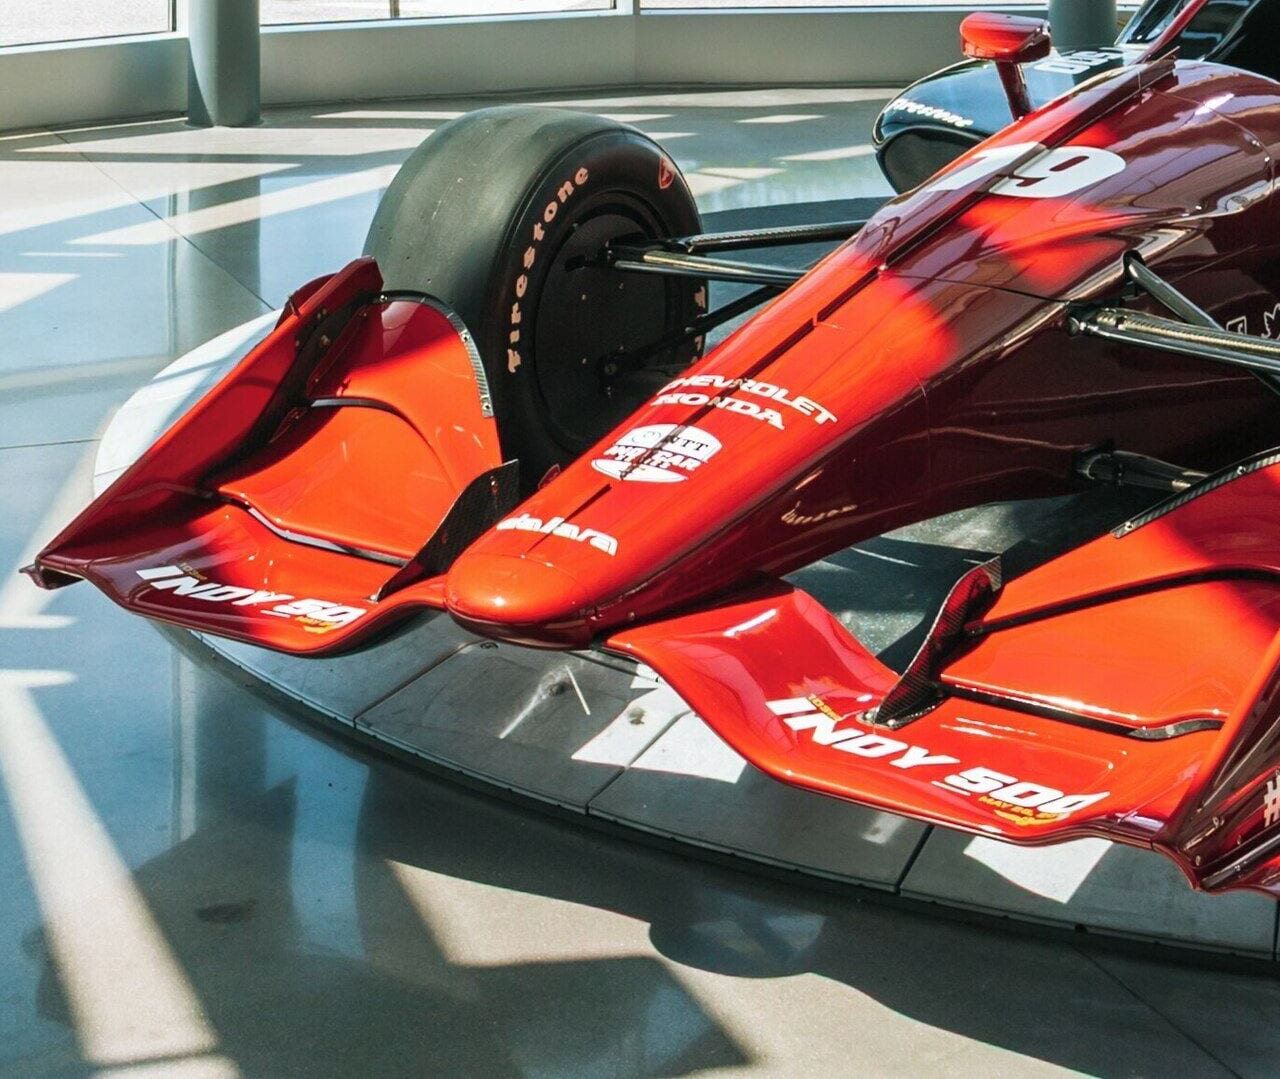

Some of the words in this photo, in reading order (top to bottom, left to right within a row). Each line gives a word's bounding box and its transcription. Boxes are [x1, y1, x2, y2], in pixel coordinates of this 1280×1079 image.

[883, 98, 974, 128] Firestone
[925, 141, 1127, 199] 19
[508, 166, 589, 374] Firestone
[650, 392, 786, 431] HONDA
[657, 374, 838, 425] CHEVROLET
[496, 513, 620, 557] dallara
[136, 564, 295, 607] INDY
[766, 696, 961, 770] INDY
[973, 766, 1111, 814] 500
